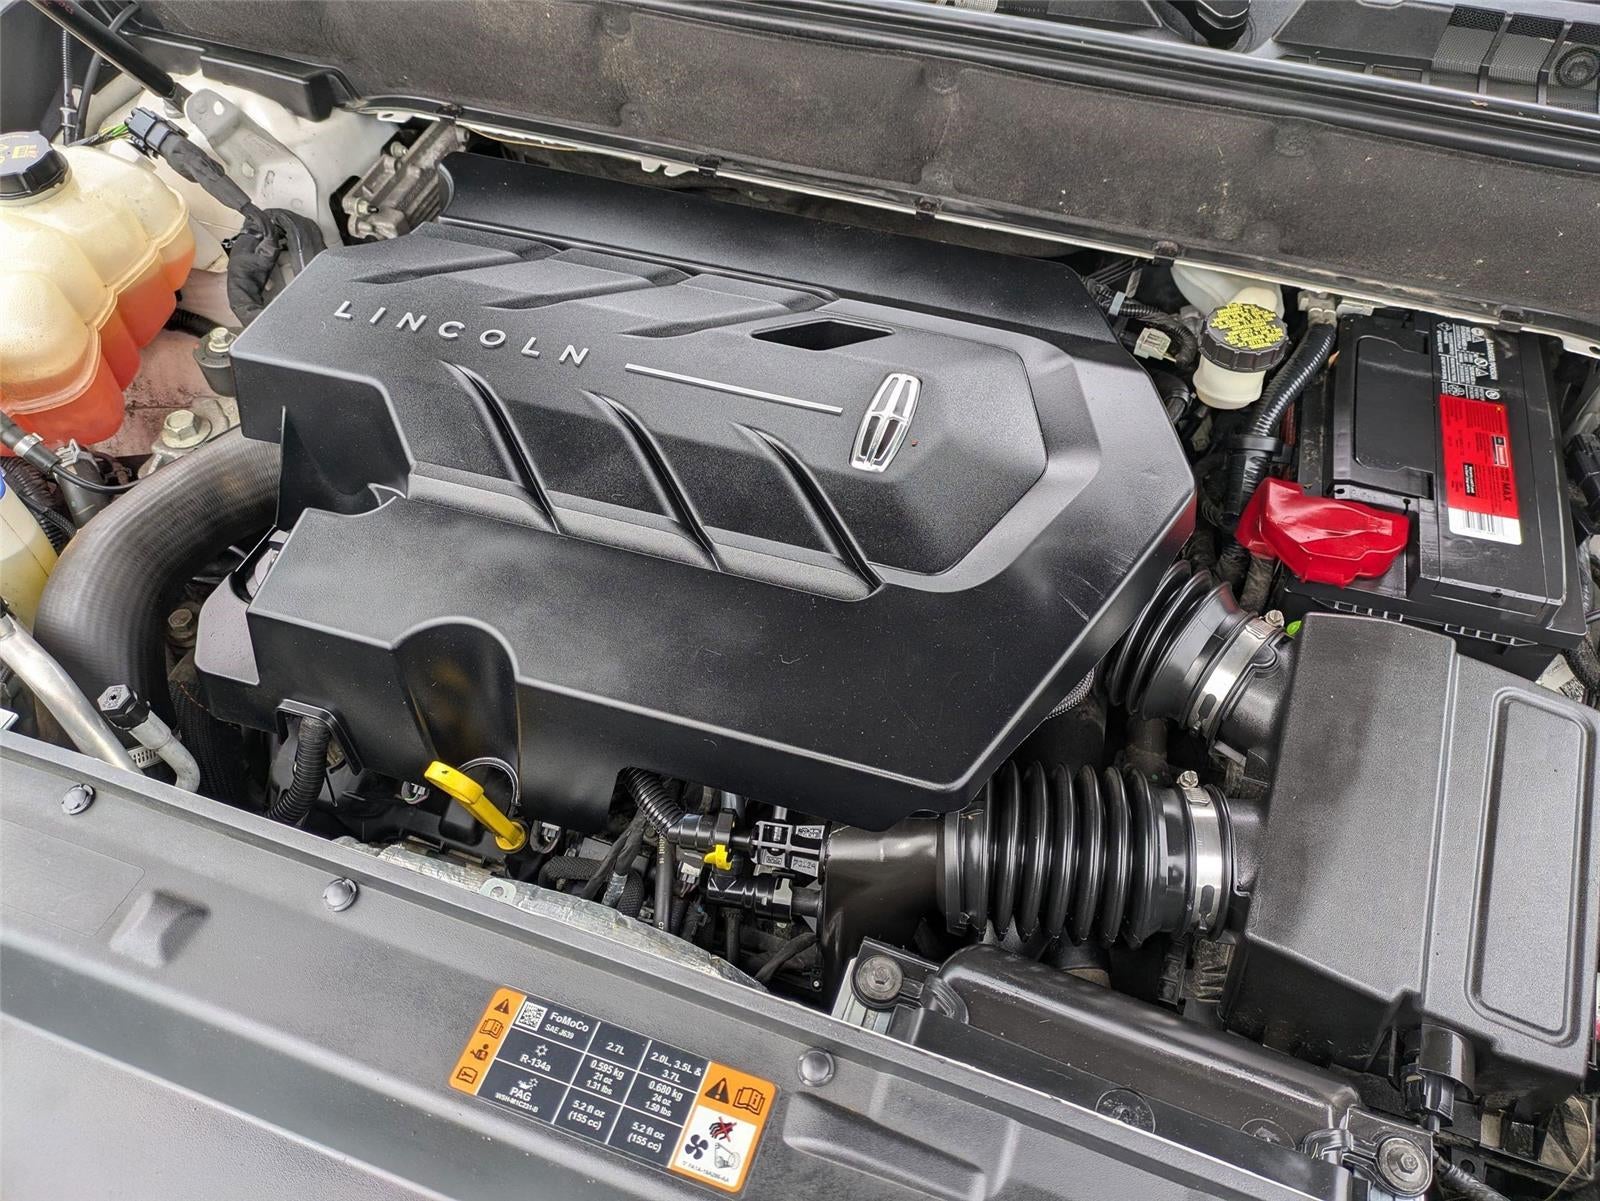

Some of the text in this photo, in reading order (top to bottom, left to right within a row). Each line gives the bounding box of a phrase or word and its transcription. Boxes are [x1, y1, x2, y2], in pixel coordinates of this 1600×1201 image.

[334, 300, 589, 367] LINCOLN
[545, 1024, 558, 1035] SAE
[550, 1012, 589, 1032] FoMoCo
[605, 1042, 625, 1055] 2.7L
[520, 1054, 552, 1072] R-134a
[590, 1060, 625, 1080] 0.595 kg
[651, 1052, 702, 1077] 2.0L, 3.5L &
[593, 1072, 613, 1085] 21 oz
[661, 1069, 680, 1082] 3.7L
[510, 1087, 532, 1102] PAG
[586, 1080, 613, 1095] 1.31 lbs
[648, 1081, 683, 1102] 0.680 kg
[572, 1100, 605, 1118] 5.2 fl oz
[645, 1101, 672, 1117] 1.50 lbs
[652, 1093, 672, 1107] 24 oz
[567, 1112, 602, 1130] (155 cc)
[632, 1121, 665, 1140] 5.2 fl oz
[627, 1132, 662, 1153] (155 cc)
